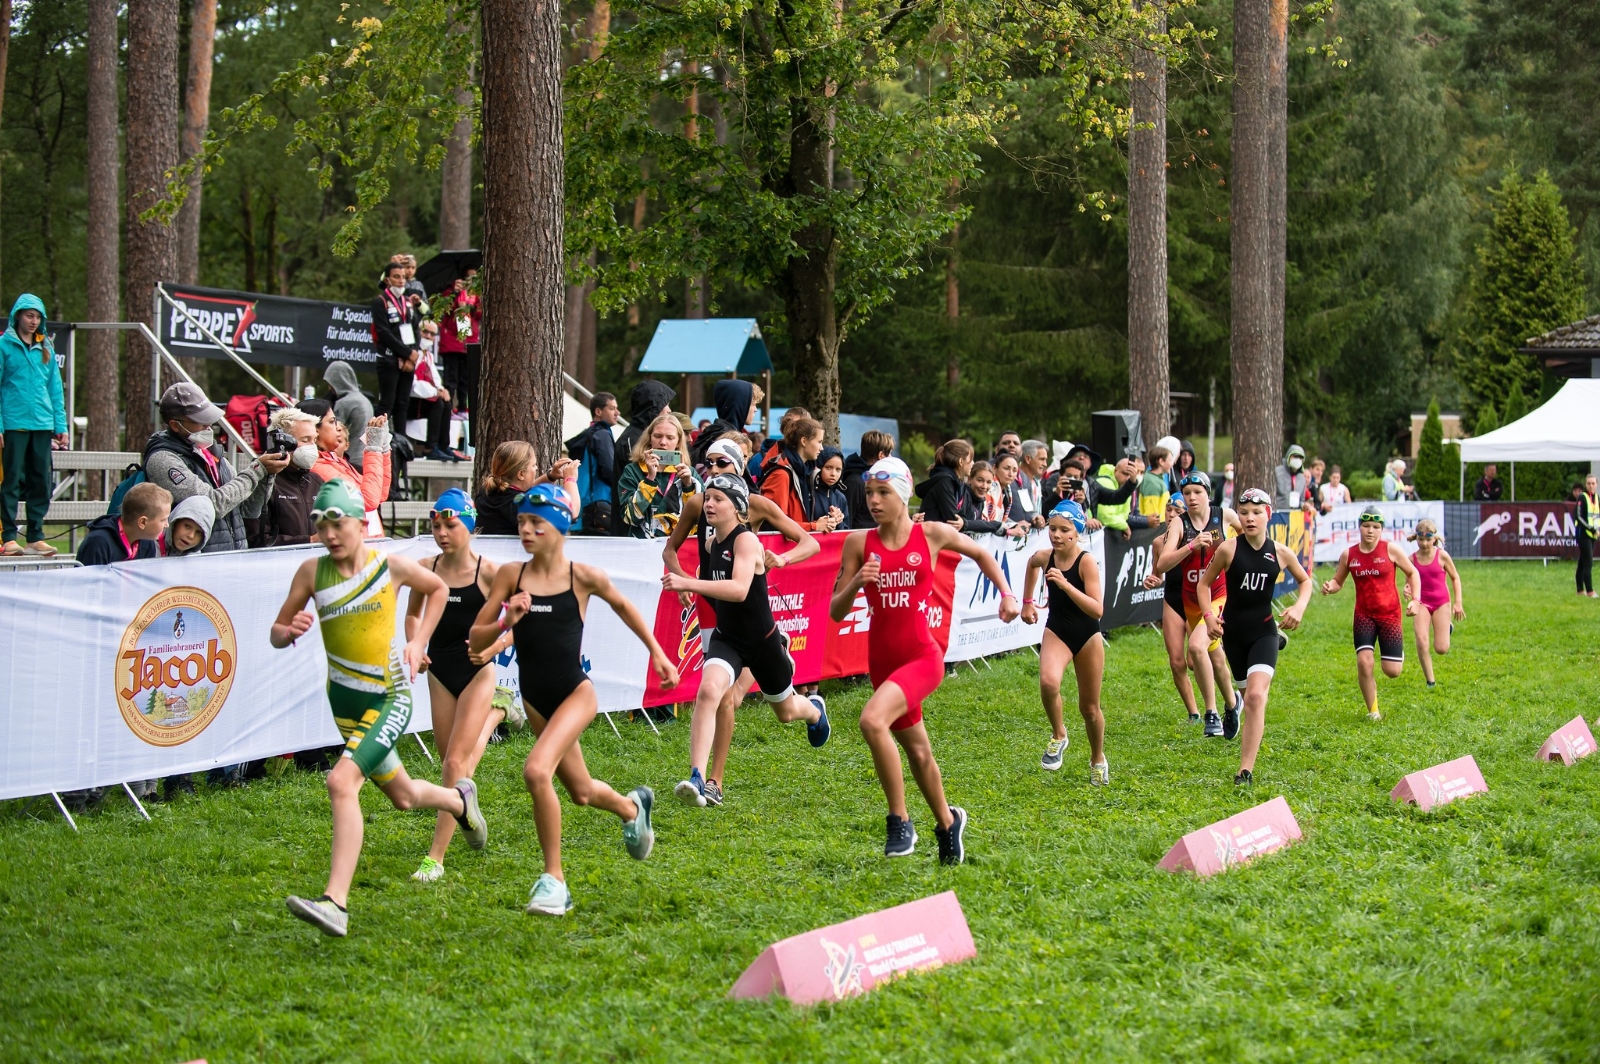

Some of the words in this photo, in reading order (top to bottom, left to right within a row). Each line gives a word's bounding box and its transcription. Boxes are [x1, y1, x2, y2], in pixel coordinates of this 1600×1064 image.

[331, 306, 344, 320] Ihr
[249, 323, 294, 344] SPORTS
[326, 325, 338, 340] für
[1518, 538, 1546, 547] SWISS
[1547, 538, 1579, 547] WATCH
[1355, 568, 1380, 577] Latvia
[1240, 572, 1268, 591] AUT
[447, 595, 462, 603] rena
[880, 591, 910, 609] TUR
[350, 601, 382, 614] AFRICA
[530, 604, 553, 612] arena
[148, 640, 205, 655] Familienbrauerei
[790, 636, 807, 651] 2021
[120, 638, 233, 701] Jacob
[375, 693, 412, 749] AFRICA
